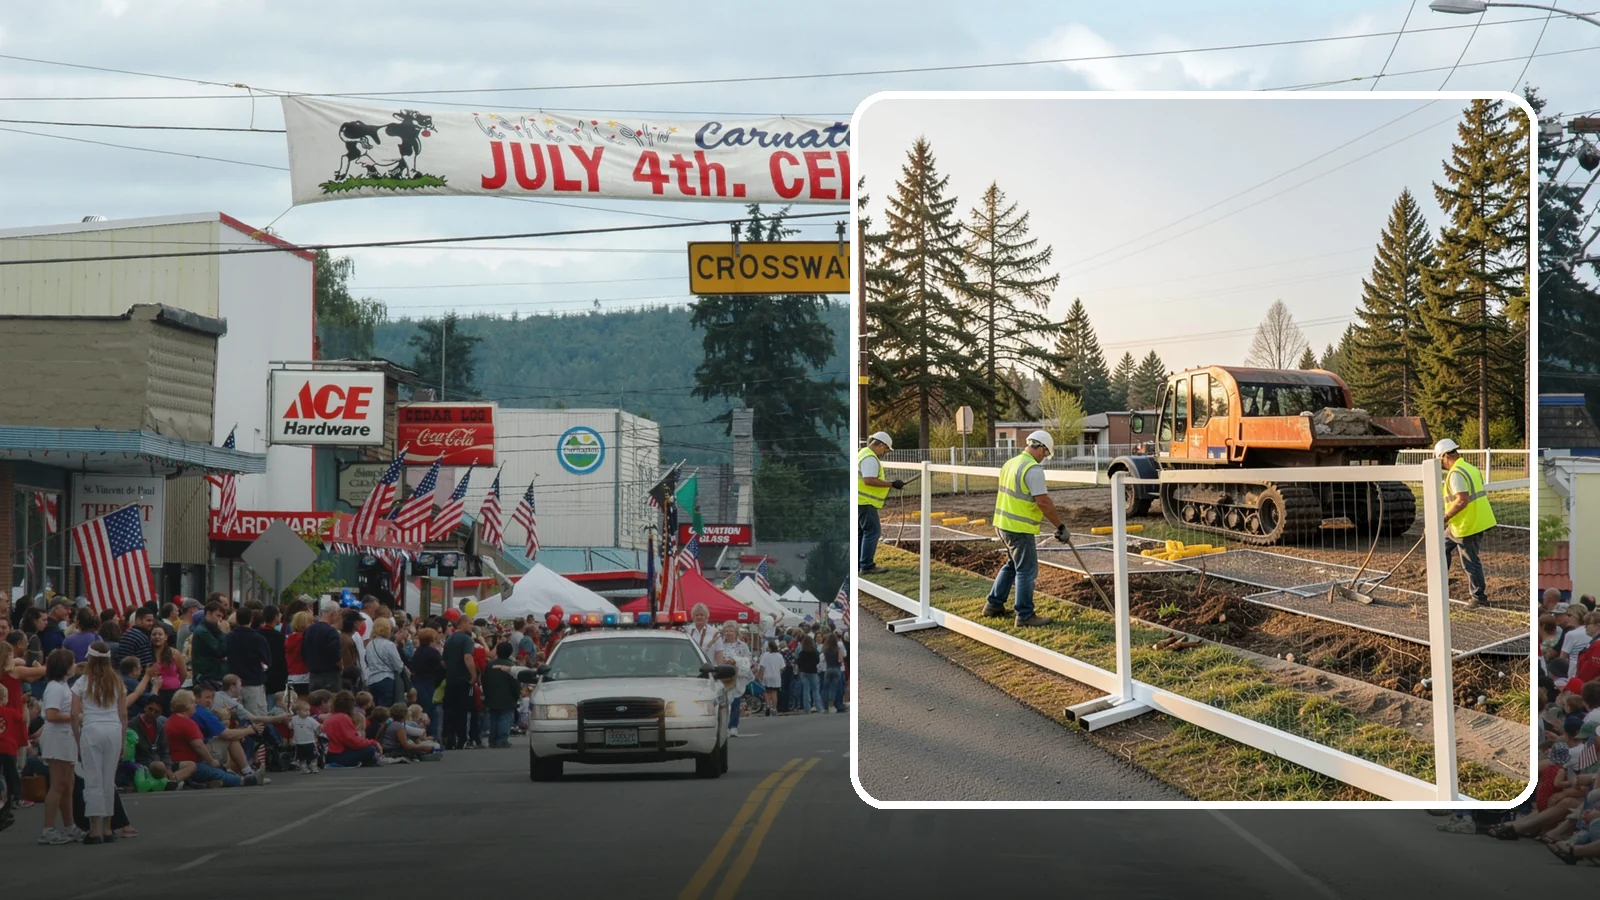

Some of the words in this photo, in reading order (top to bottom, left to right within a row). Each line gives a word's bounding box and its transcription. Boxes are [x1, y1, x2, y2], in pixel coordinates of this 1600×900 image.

[695, 121, 850, 150] Carnat
[481, 141, 604, 192] JULY
[632, 150, 746, 197] 4th.
[697, 254, 850, 280] CROSSWA
[282, 380, 373, 420] ACE
[406, 409, 452, 421] CEDAR
[461, 409, 485, 421] LOG
[283, 421, 370, 436] Hardware
[416, 428, 477, 446] Coca-Cola
[83, 485, 94, 494] St.
[95, 485, 124, 494] Vincent
[126, 486, 135, 495] de
[137, 486, 155, 495] Paul
[688, 526, 741, 534] CRNATION
[699, 535, 730, 543] GLASS
